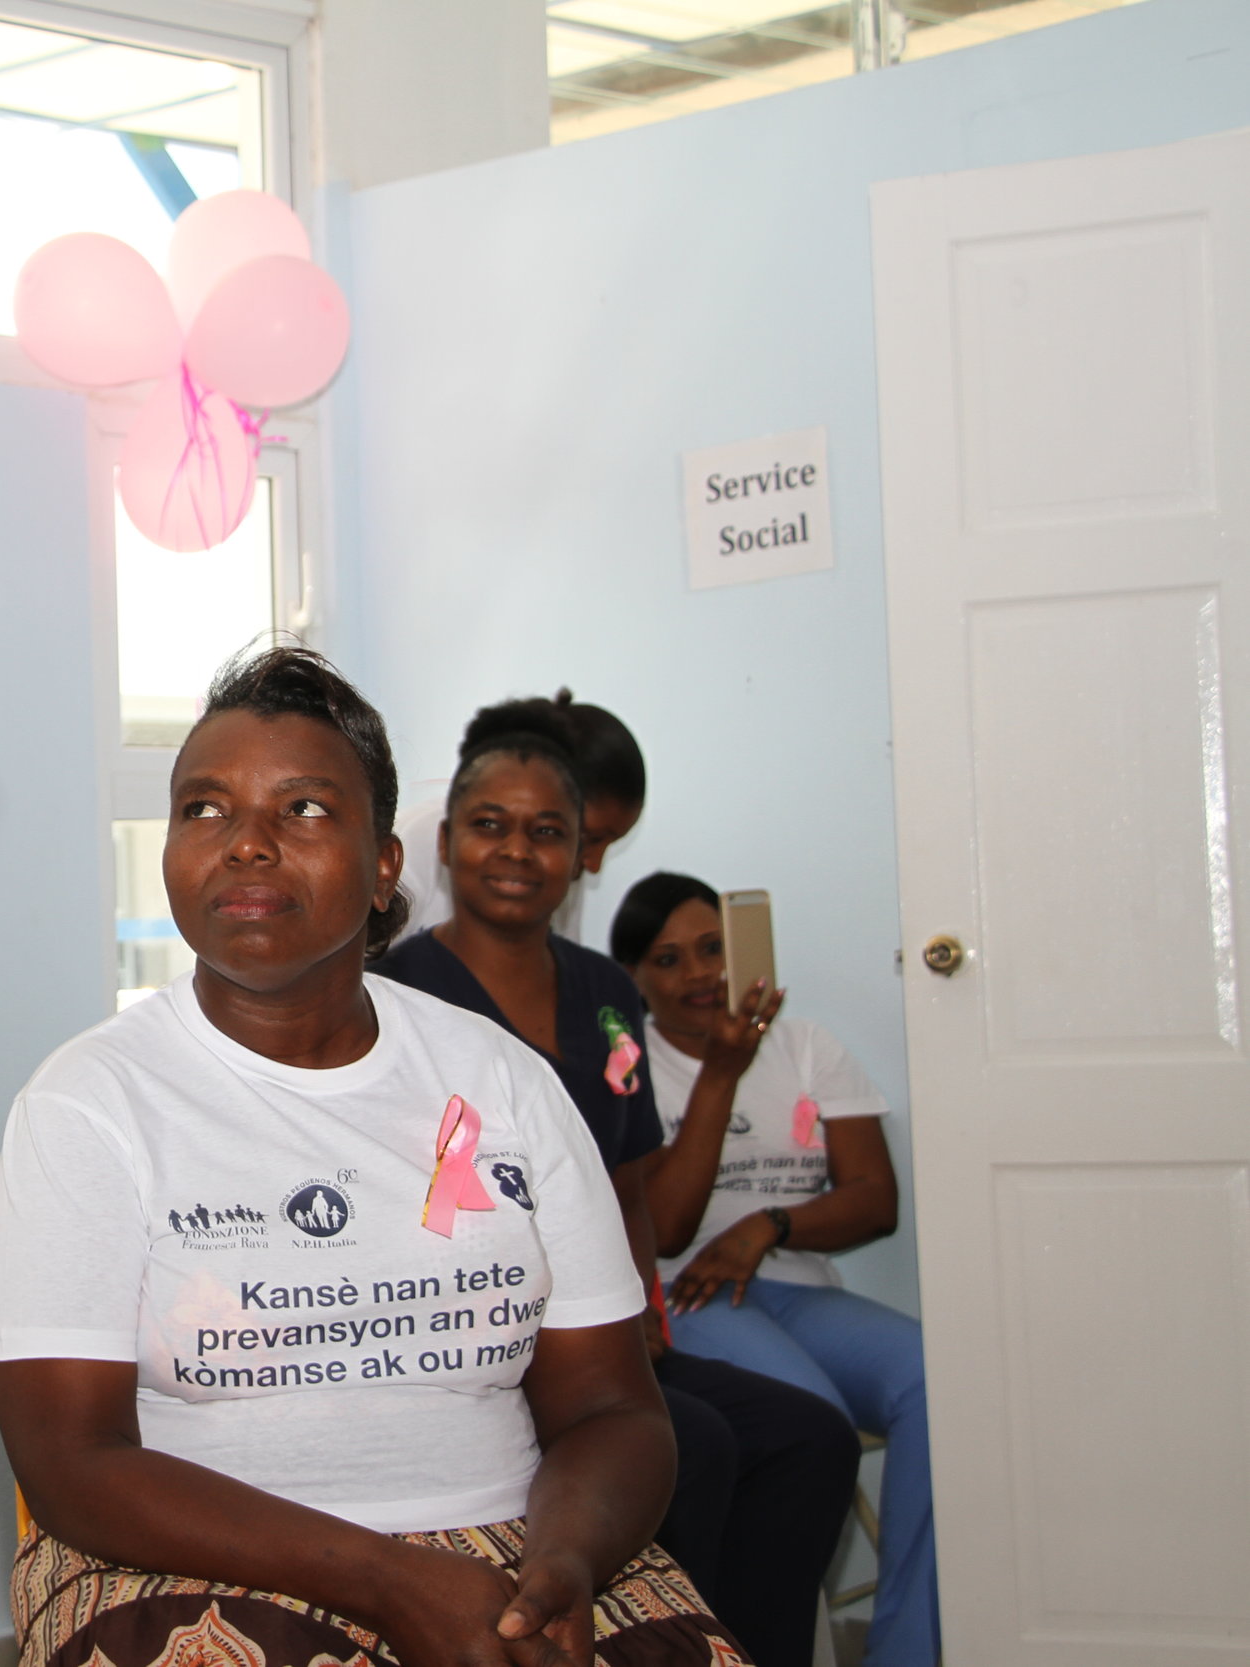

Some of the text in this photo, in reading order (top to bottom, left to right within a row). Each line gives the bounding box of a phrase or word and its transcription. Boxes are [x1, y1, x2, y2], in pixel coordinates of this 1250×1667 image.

[706, 461, 816, 504] Service
[719, 511, 809, 556] Social
[182, 1236, 269, 1250] Francesca Rava
[184, 1226, 269, 1240] FONDAZIONE
[327, 1238, 357, 1248] Italia
[241, 1262, 525, 1310] Kansè nan tete
[197, 1297, 545, 1357] prevansyon an dwe
[173, 1357, 347, 1388] kòmanse
[361, 1349, 407, 1379] ak
[418, 1348, 463, 1372] ou
